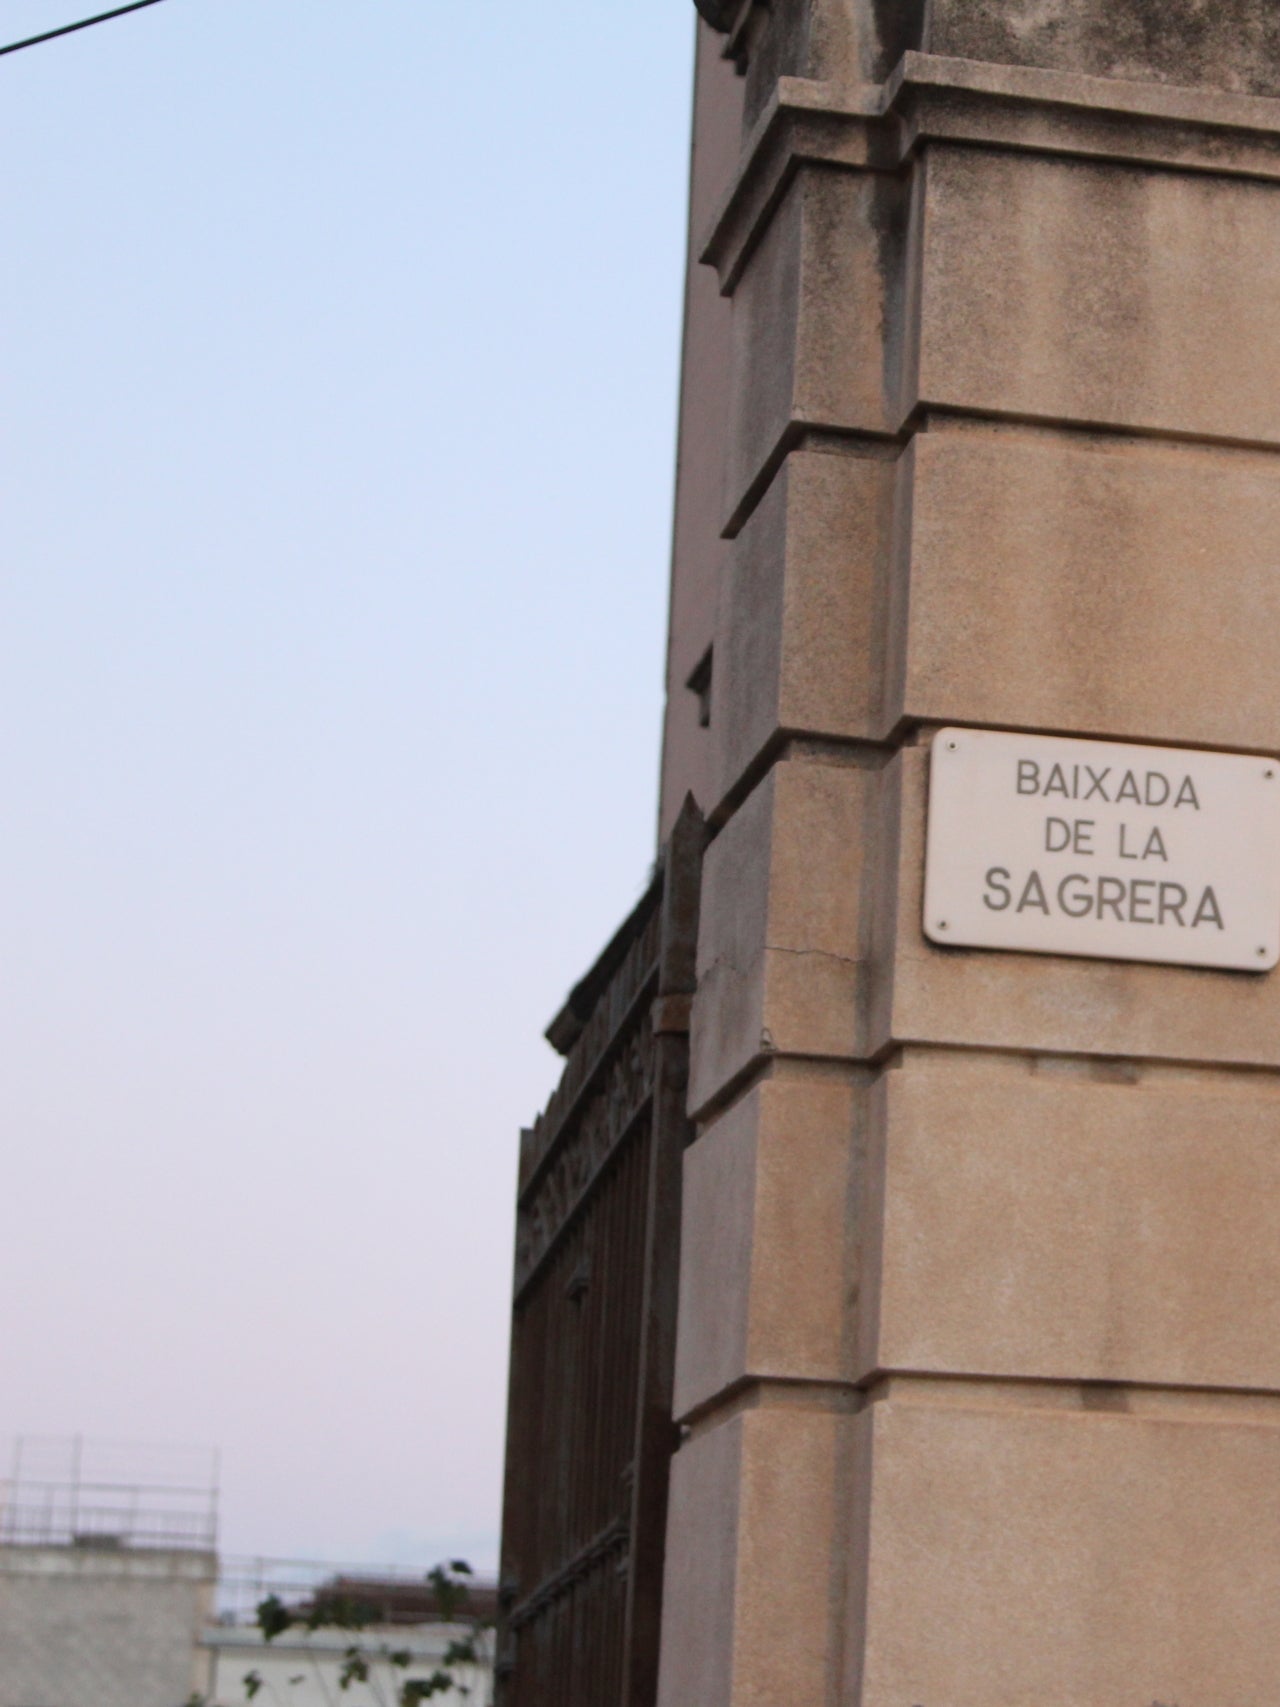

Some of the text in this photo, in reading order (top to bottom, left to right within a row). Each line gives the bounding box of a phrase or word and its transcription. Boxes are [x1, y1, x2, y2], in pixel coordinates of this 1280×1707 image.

[1016, 759, 1200, 811] BAIXADA
[1044, 816, 1169, 862] DE LA
[982, 866, 1225, 931] SAGRERA
